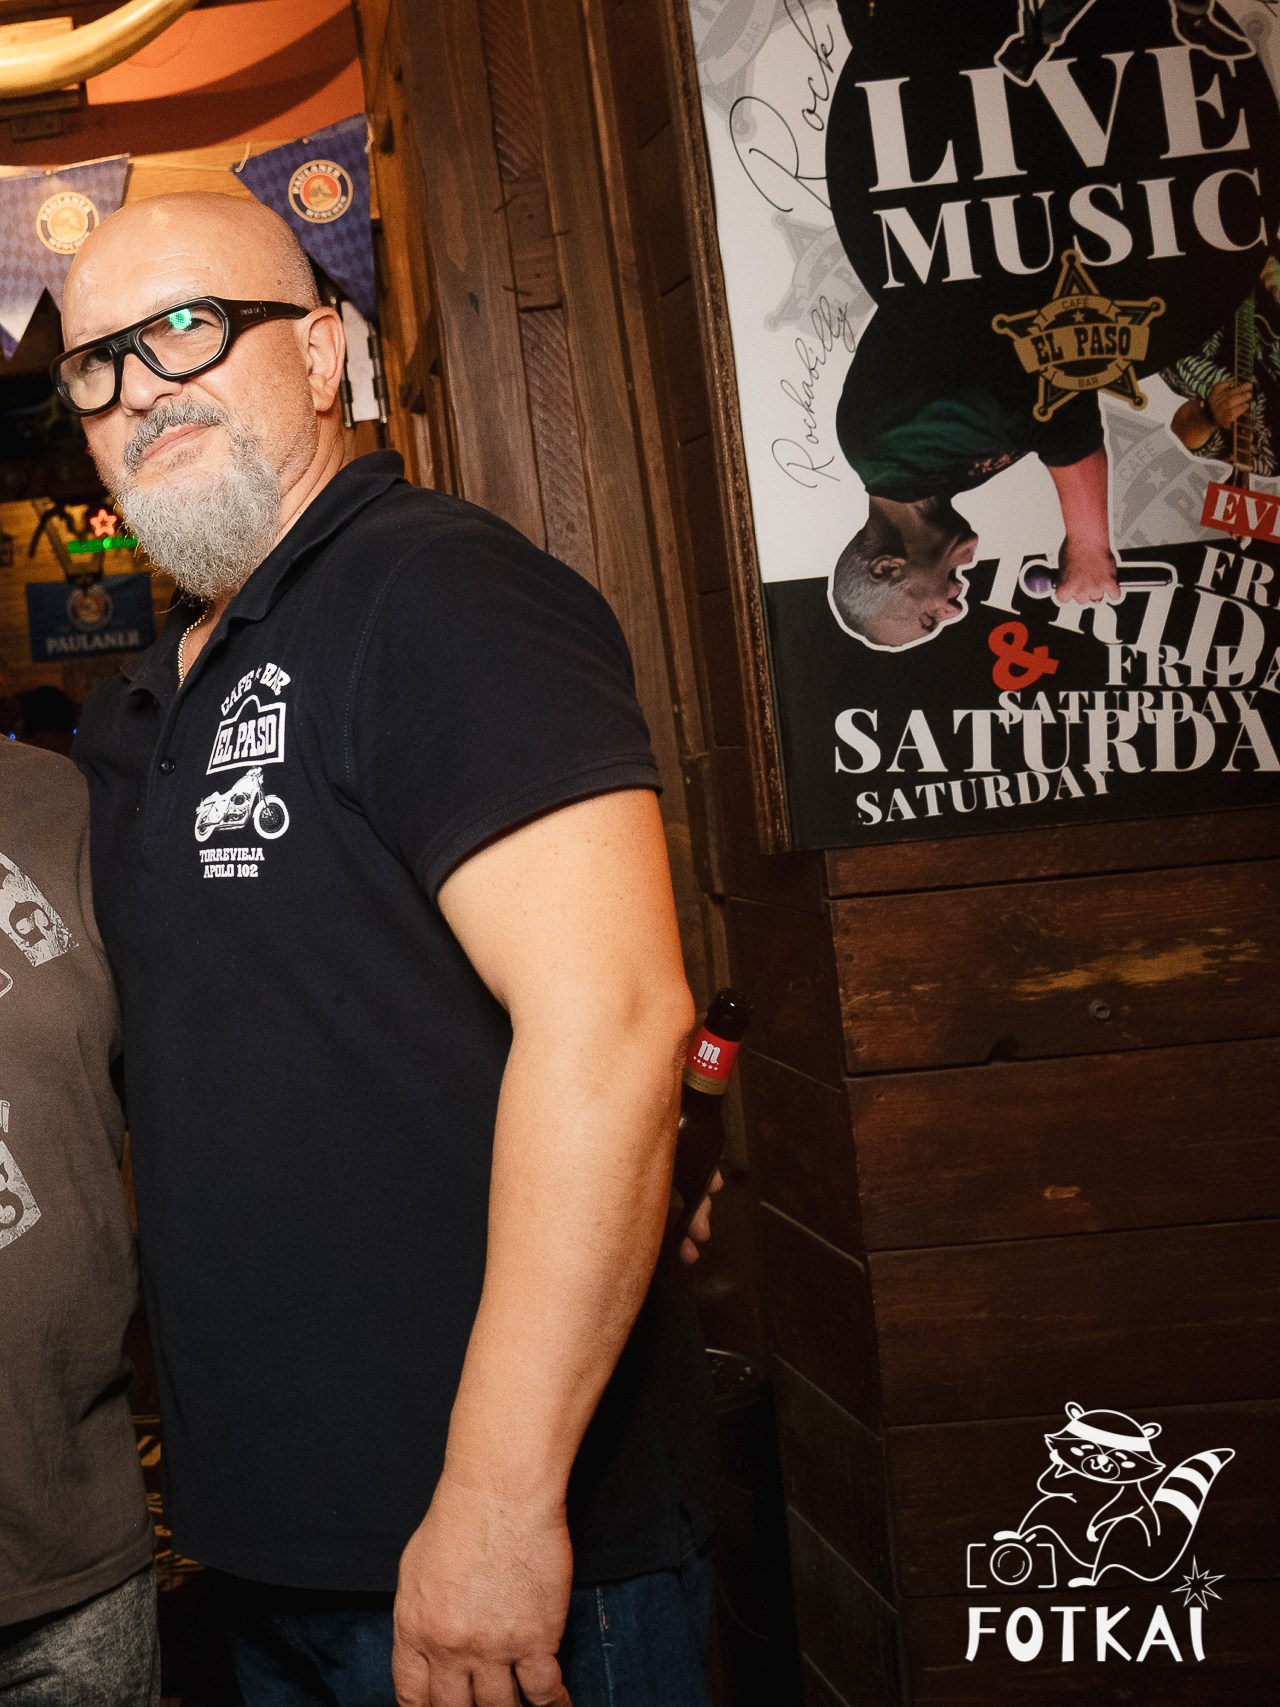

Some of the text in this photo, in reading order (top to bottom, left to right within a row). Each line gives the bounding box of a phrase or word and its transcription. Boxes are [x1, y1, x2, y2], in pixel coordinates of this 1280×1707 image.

[854, 44, 1252, 193] LIVE
[292, 164, 342, 195] PAULANER
[41, 195, 93, 222] PAULANER
[873, 166, 1269, 290] MUSIC
[1030, 325, 1132, 366] EL PASO
[771, 295, 857, 488] Rockabilly
[1077, 376, 1099, 388] BAR
[1195, 544, 1280, 612] FR
[987, 620, 1061, 691] &
[260, 662, 292, 697] BAR
[212, 713, 279, 767] EL PASO
[855, 760, 1111, 827] SATURDAY
[198, 847, 266, 864] TORREVIEJA
[203, 863, 260, 879] APOLO 102
